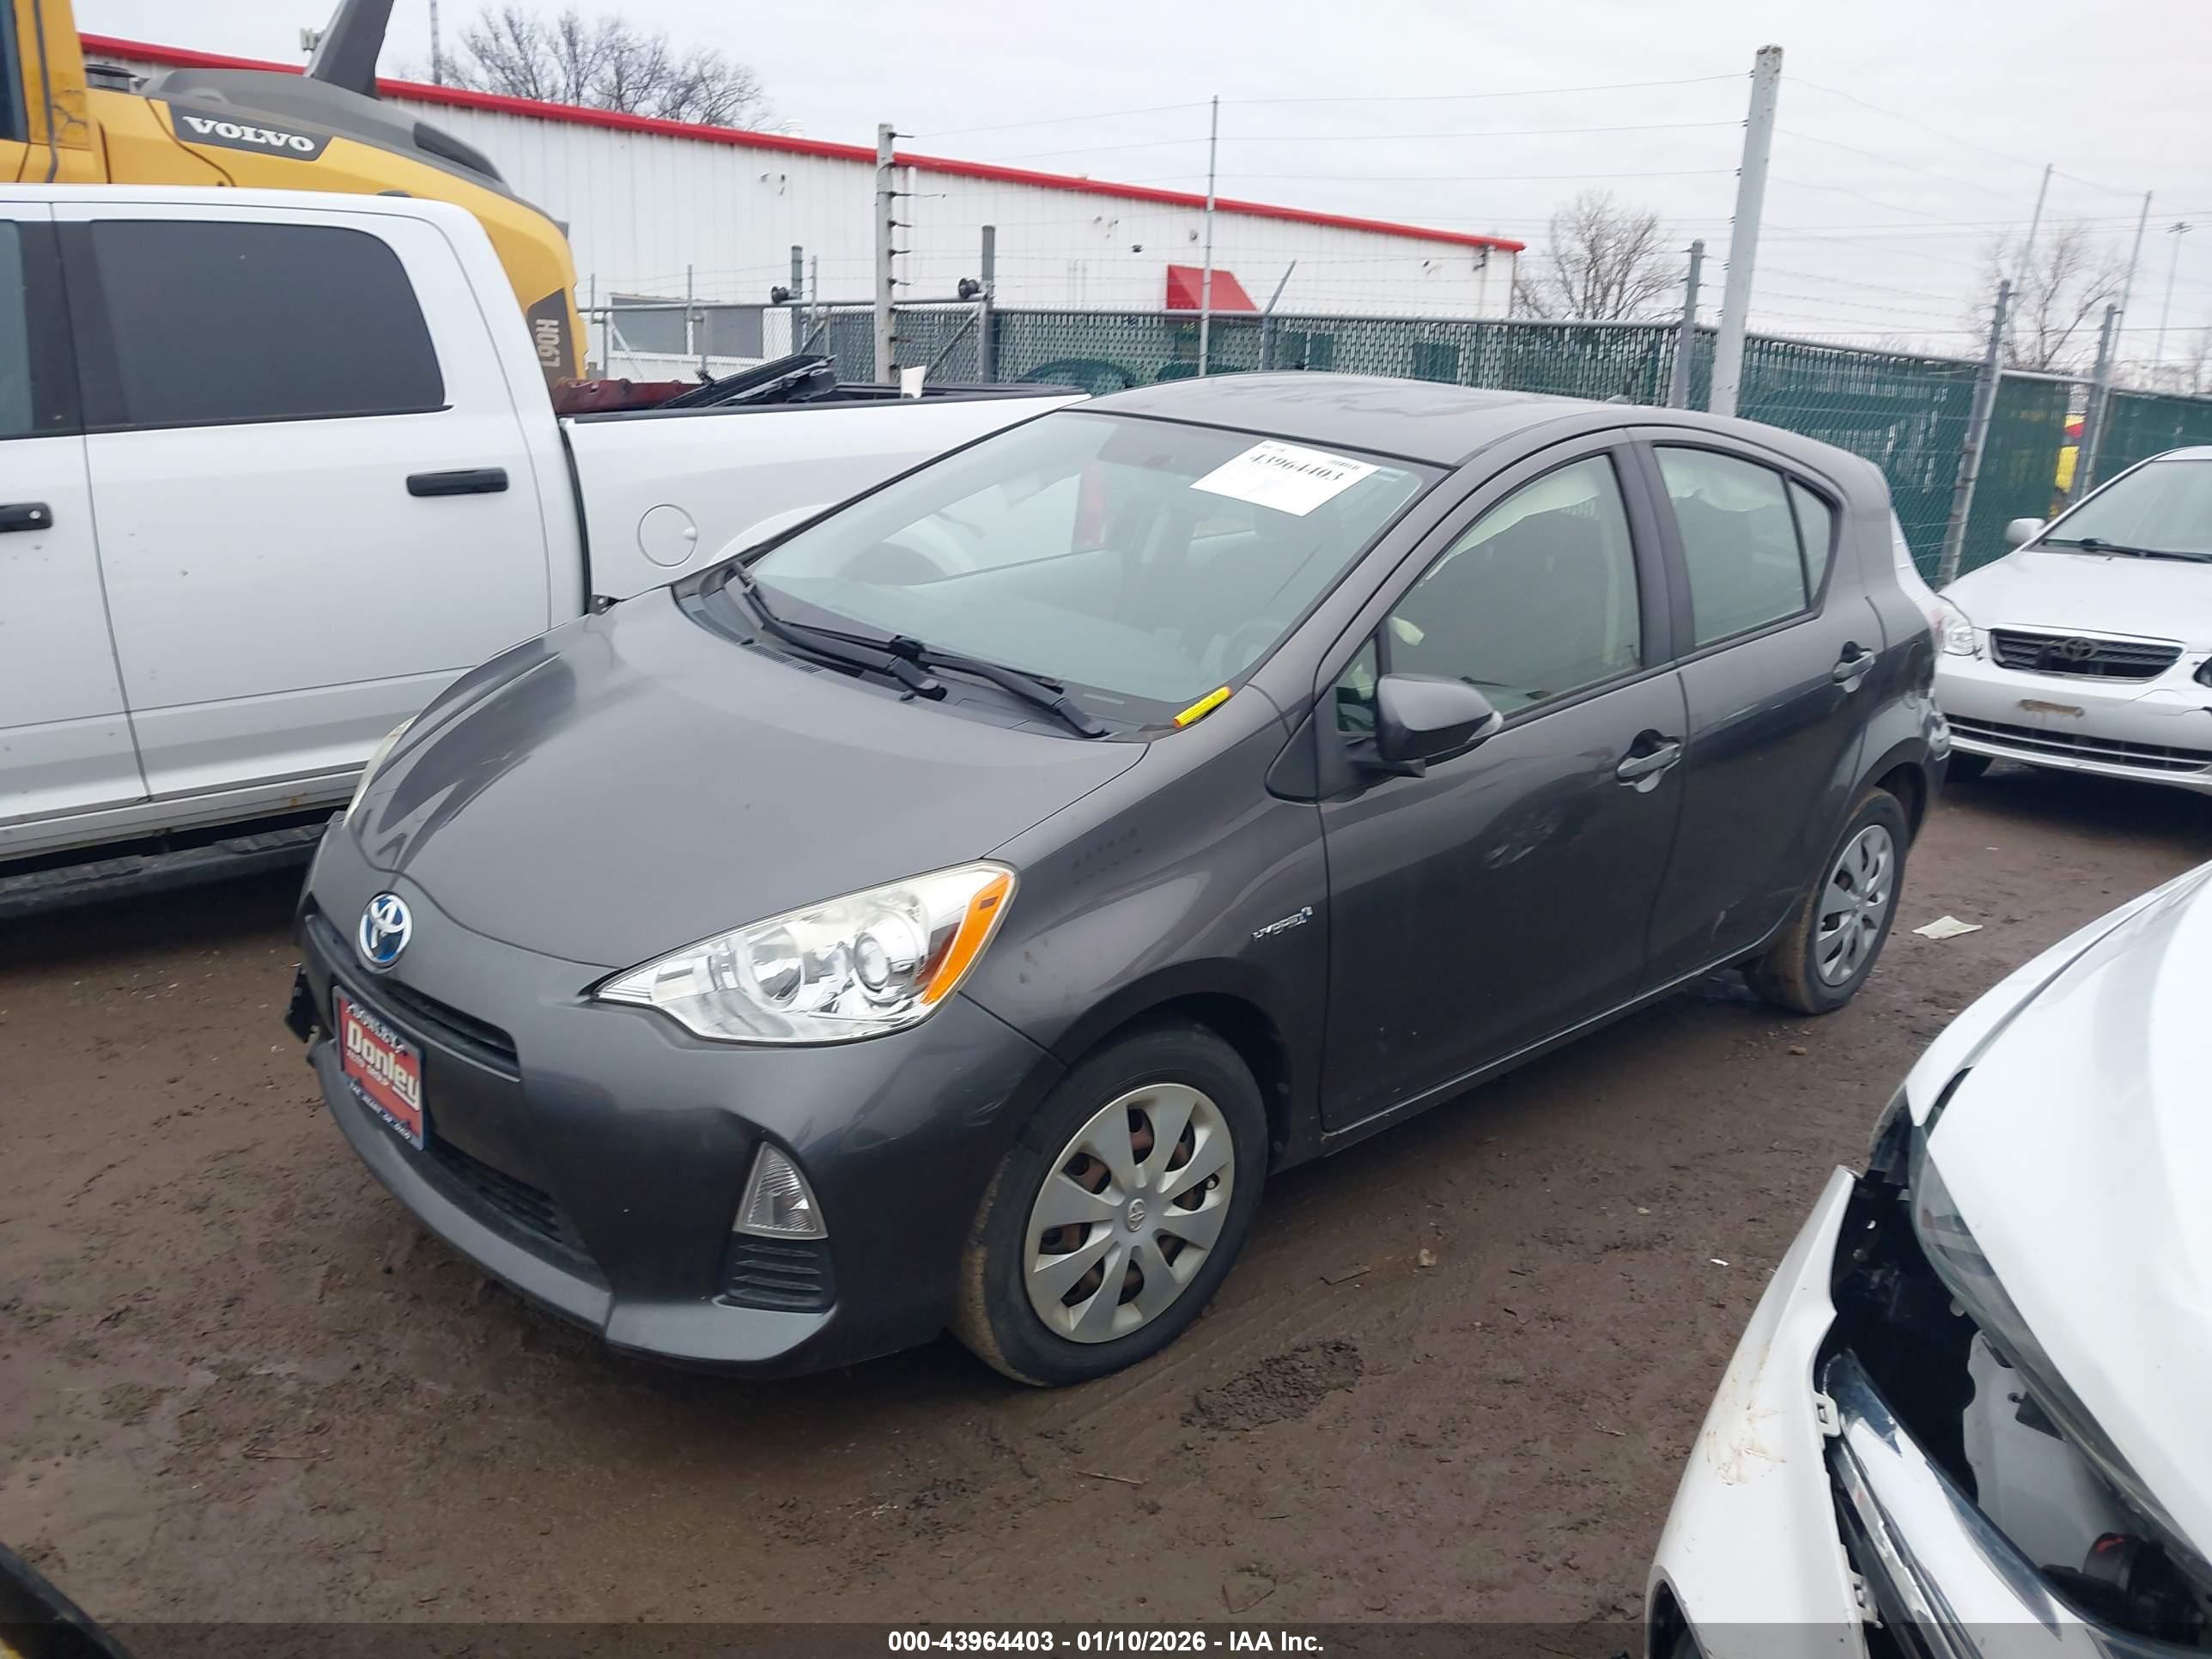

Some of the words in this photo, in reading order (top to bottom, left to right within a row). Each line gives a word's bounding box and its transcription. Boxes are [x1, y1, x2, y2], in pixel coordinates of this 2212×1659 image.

[182, 116, 315, 152] VOLVO
[535, 319, 561, 368] L90H
[1250, 453, 1345, 482] 43964403
[347, 1019, 421, 1111] Donley
